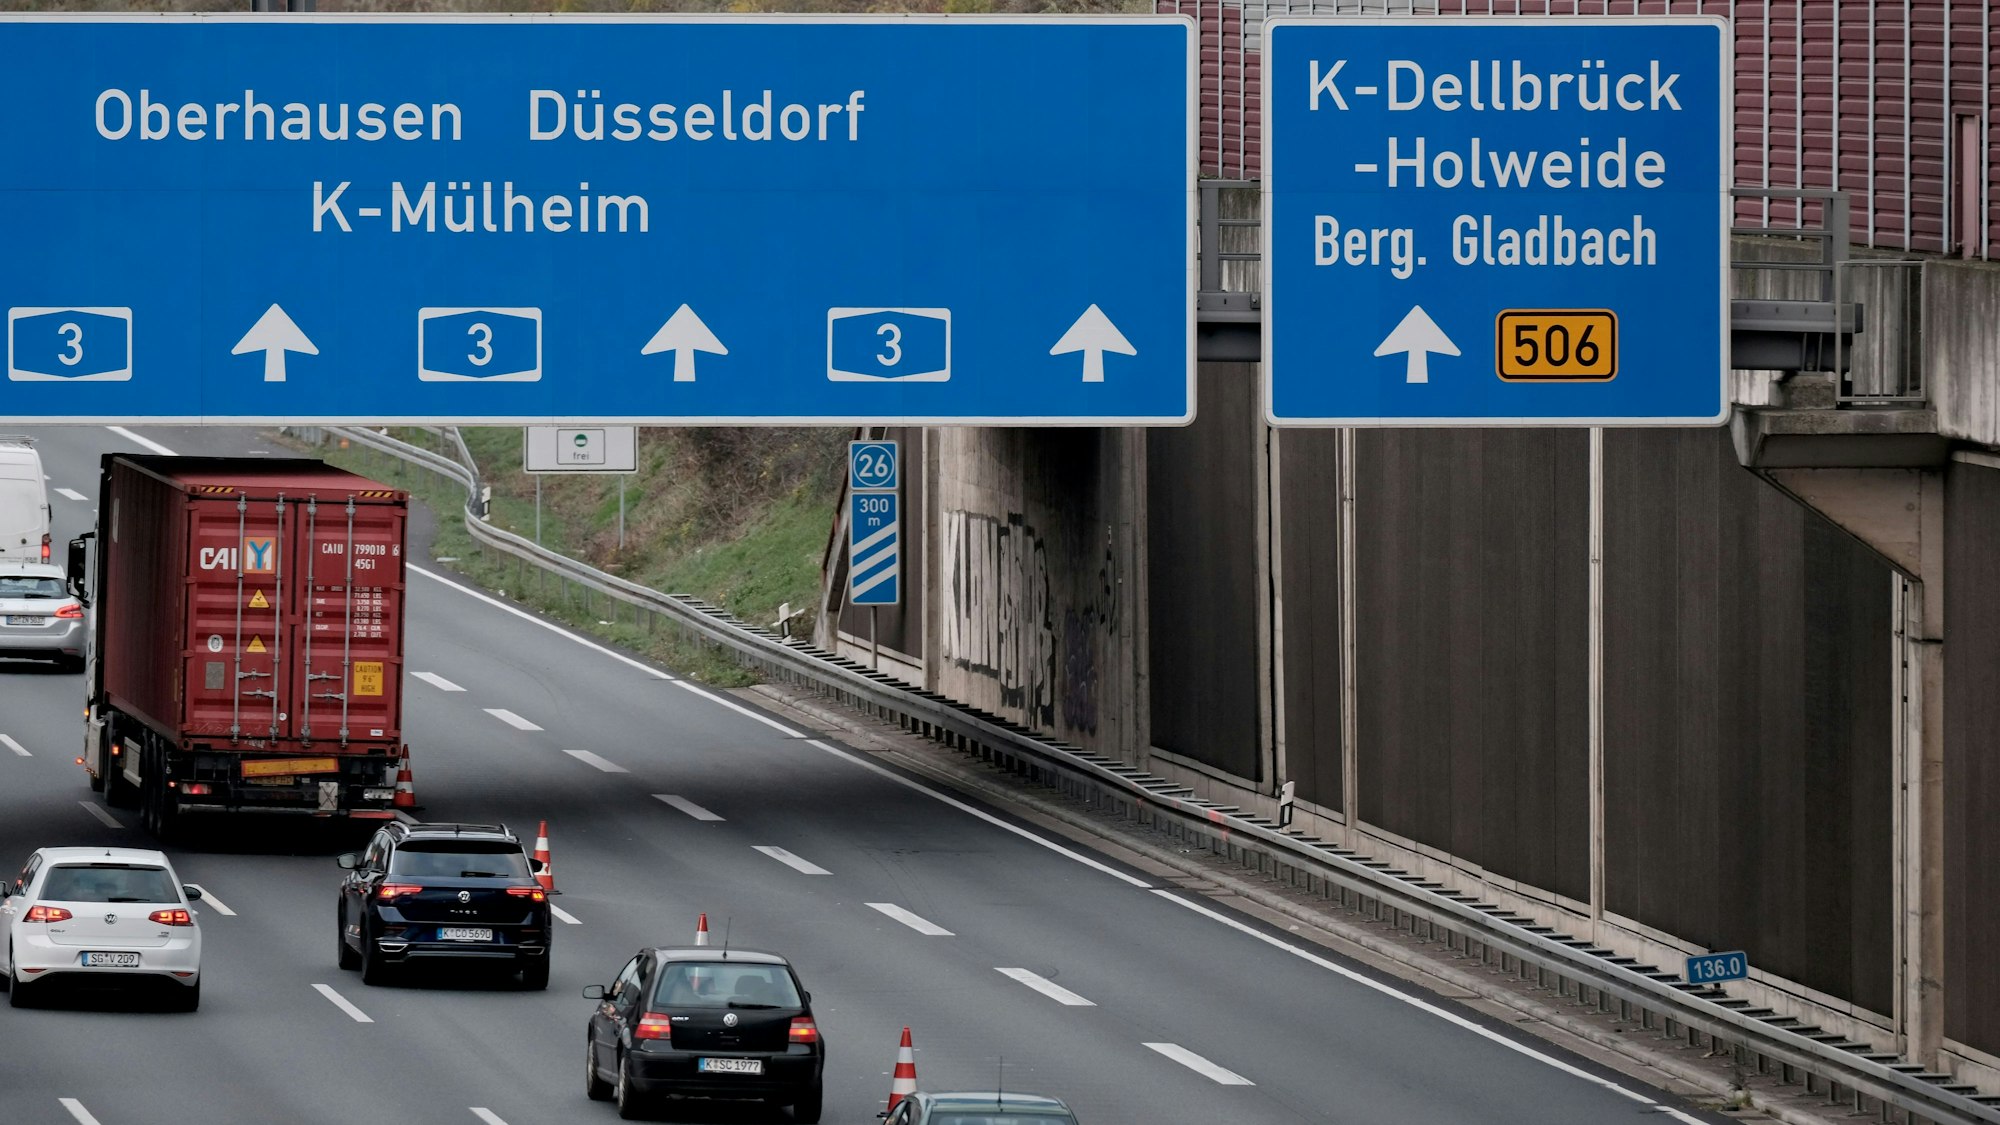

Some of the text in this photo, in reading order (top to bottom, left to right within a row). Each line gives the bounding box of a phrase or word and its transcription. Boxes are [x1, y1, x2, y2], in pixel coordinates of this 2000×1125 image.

[1310, 60, 1681, 112] K-Dellbrück
[96, 89, 864, 141] Oberhausen Düsseldorf
[1355, 137, 1665, 189] -Holweide
[313, 181, 649, 233] K-Mülheim
[1315, 215, 1656, 279] Berg. Gladbach
[57, 323, 83, 366] 3
[467, 323, 493, 366] 3
[876, 323, 902, 366] 3
[1515, 325, 1600, 367] 506
[573, 451, 589, 460] frei
[859, 454, 888, 477] 26
[860, 498, 888, 513] 300
[868, 517, 880, 526] m
[200, 547, 237, 570] CAI
[322, 543, 399, 556] CAIU 799018 6
[354, 559, 375, 569] 45G1
[444, 929, 449, 938] K
[468, 929, 491, 939] 5690
[91, 954, 135, 964] SG V 209
[1693, 957, 1741, 979] 136.0
[705, 1060, 760, 1071] K SC 1977
